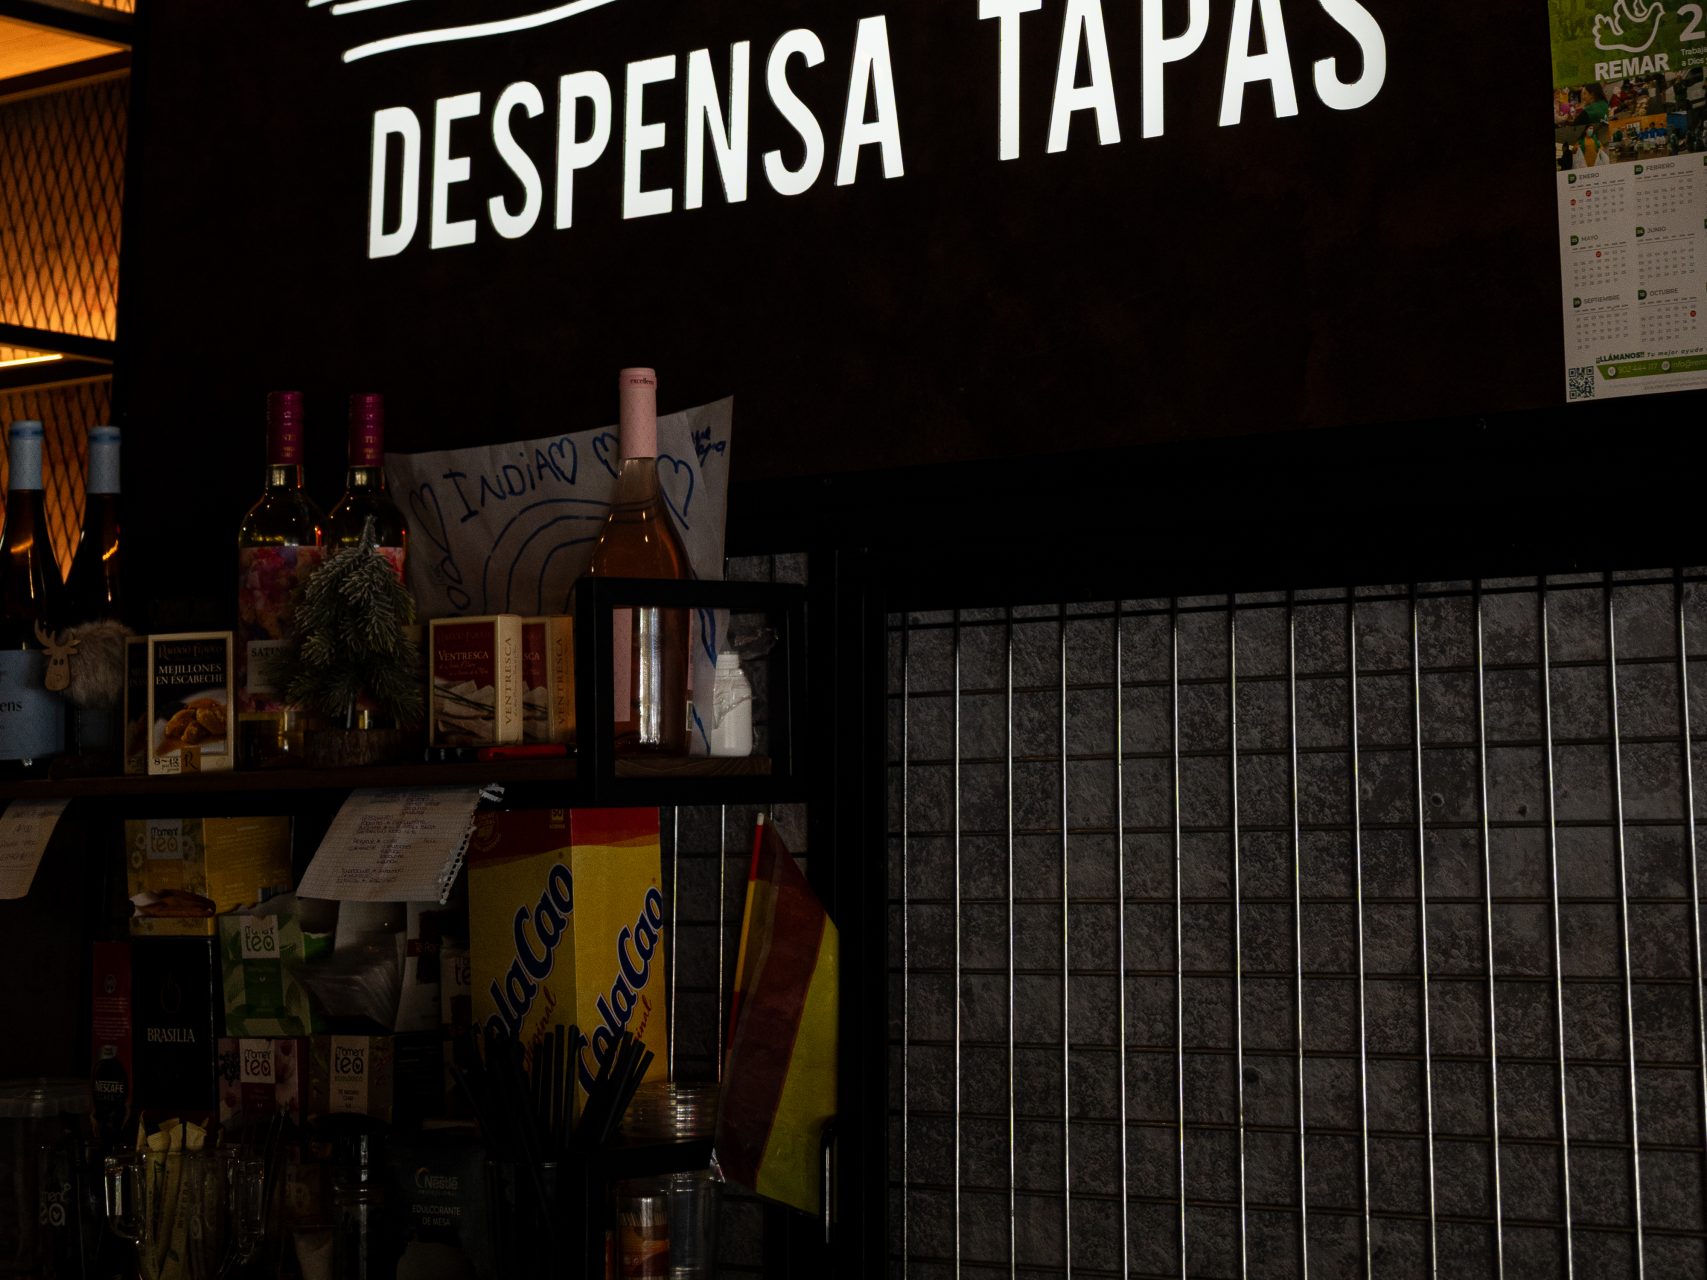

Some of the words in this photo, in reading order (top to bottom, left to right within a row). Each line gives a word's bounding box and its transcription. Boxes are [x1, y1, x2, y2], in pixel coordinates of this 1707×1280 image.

[1594, 53, 1670, 80] REMAR
[367, 15, 904, 260] DESPENSA
[437, 649, 489, 662] VENTRESCA
[158, 663, 223, 676] MEJILLONES
[156, 676, 174, 686] EN
[180, 673, 225, 685] ESCABECHE
[504, 637, 512, 726] VENTRESCA
[246, 933, 275, 953] tea
[146, 1026, 196, 1044] BRASILIA
[245, 1057, 272, 1077] tea
[334, 1056, 364, 1075] tea
